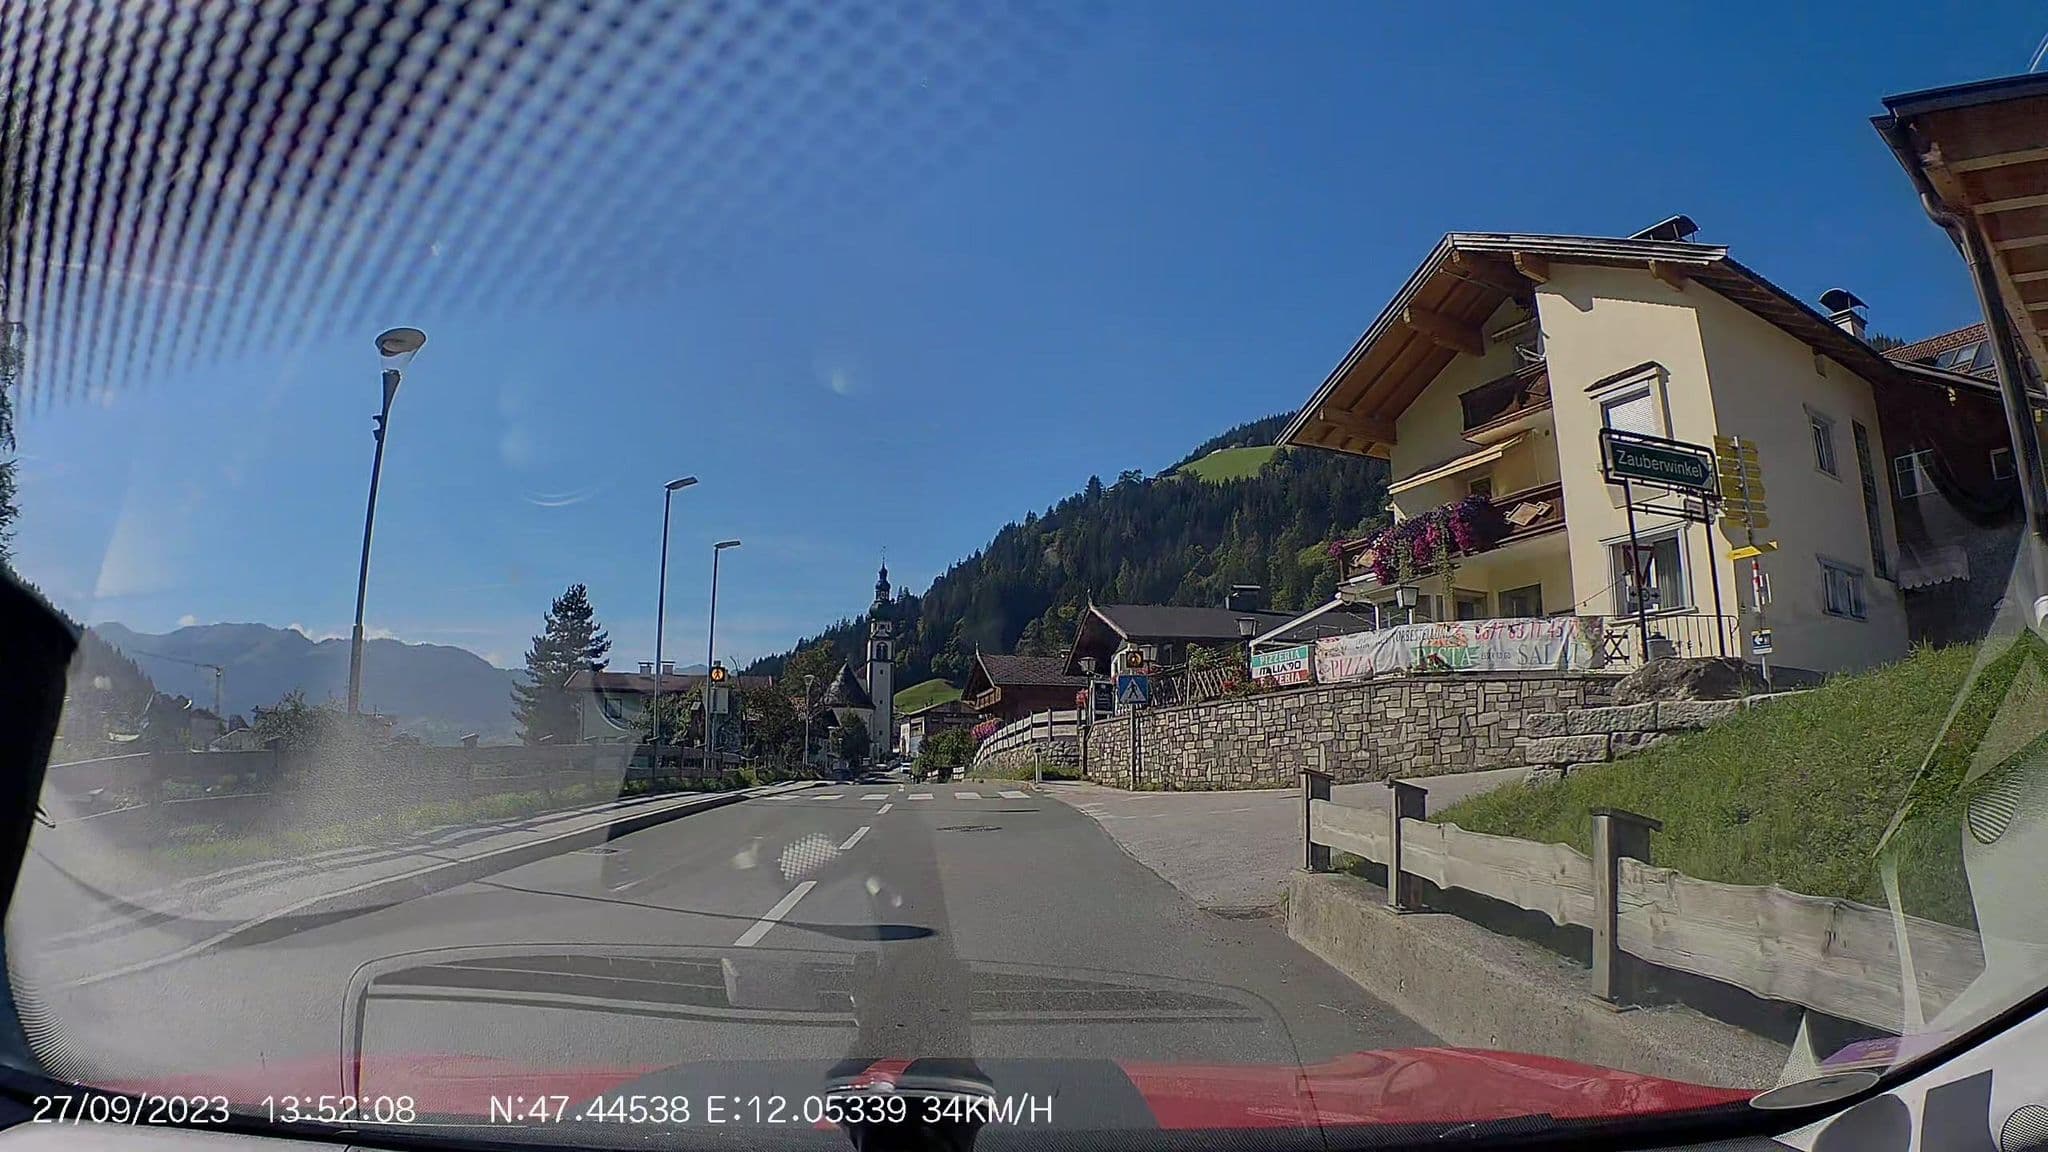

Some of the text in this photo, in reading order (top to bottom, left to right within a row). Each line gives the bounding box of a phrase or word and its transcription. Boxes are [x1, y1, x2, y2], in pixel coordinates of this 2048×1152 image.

[1616, 449, 1703, 478] Zauberwinkel
[1259, 649, 1301, 666] PIZZERIA
[1330, 656, 1374, 678] PIZZA
[1259, 671, 1301, 688] PZERIA
